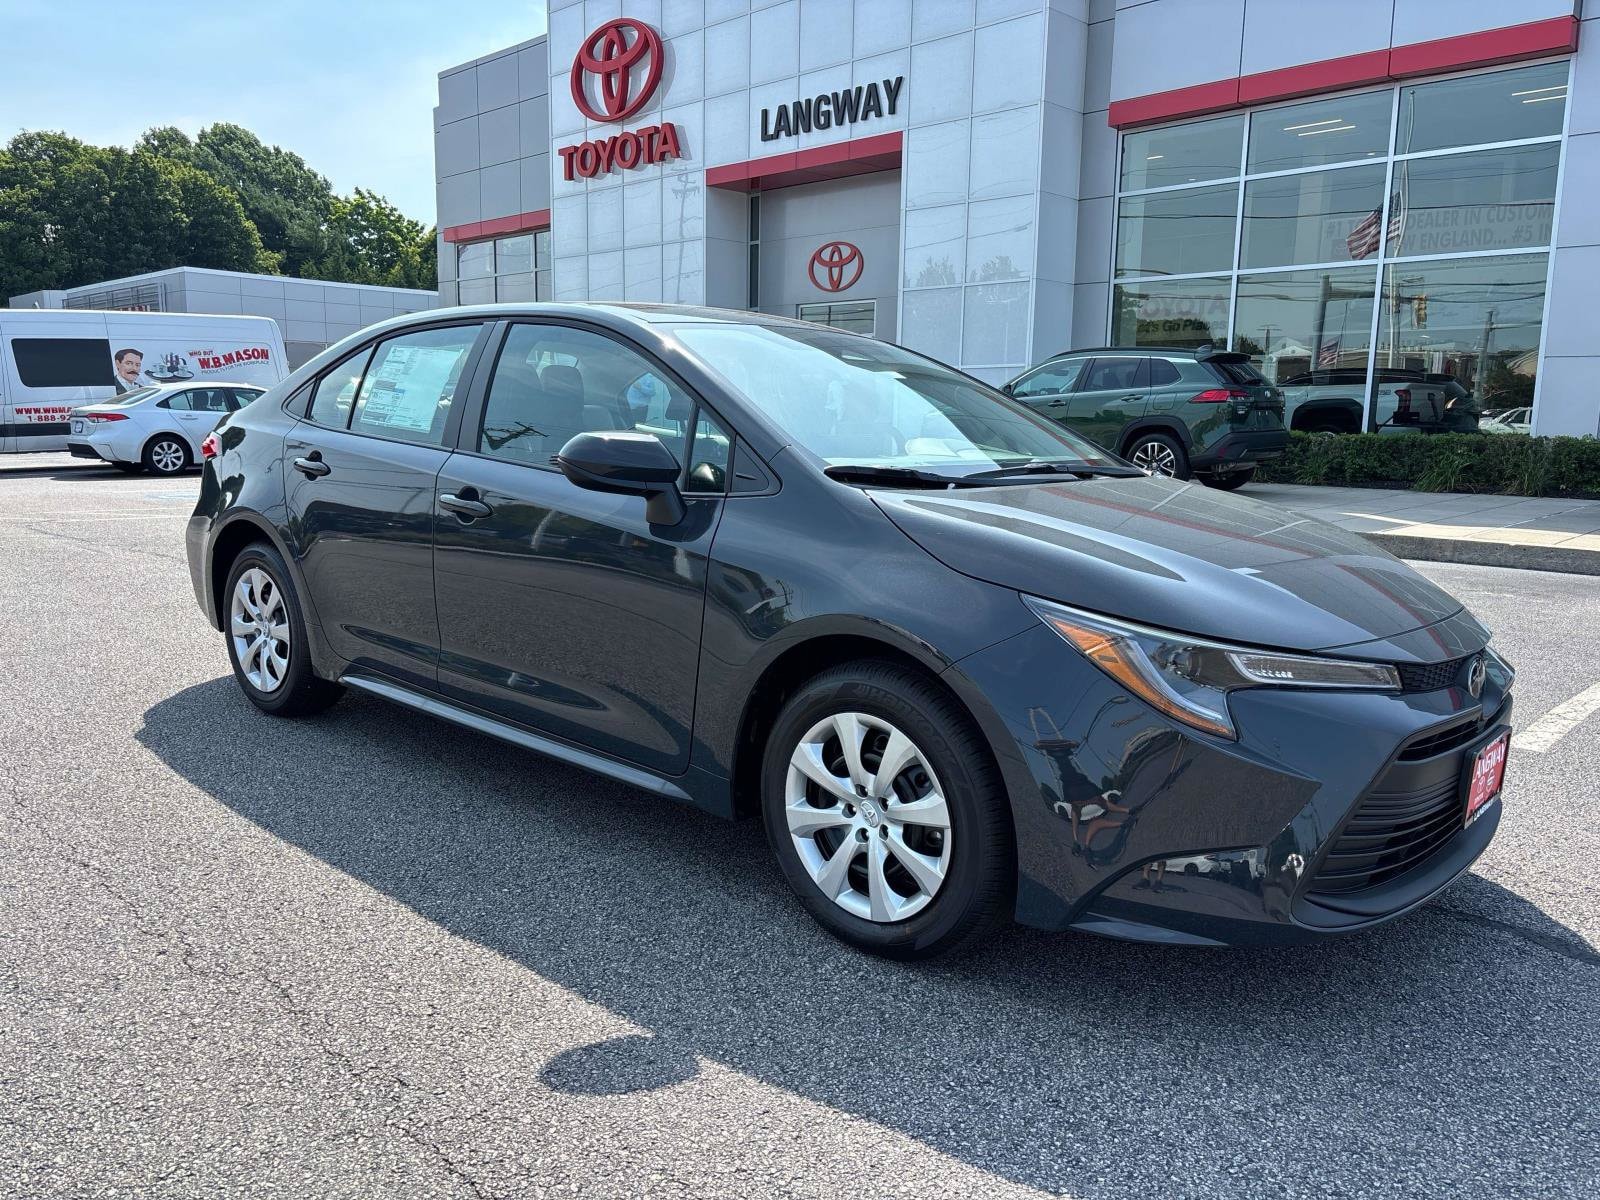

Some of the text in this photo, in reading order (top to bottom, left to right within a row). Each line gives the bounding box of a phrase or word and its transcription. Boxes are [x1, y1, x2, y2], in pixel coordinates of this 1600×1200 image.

[760, 75, 904, 142] LANGWAY
[557, 122, 681, 182] TOYOTA
[1407, 209, 1460, 230] DEALER
[1463, 207, 1481, 226] IN
[198, 348, 270, 370] W.B.MASON
